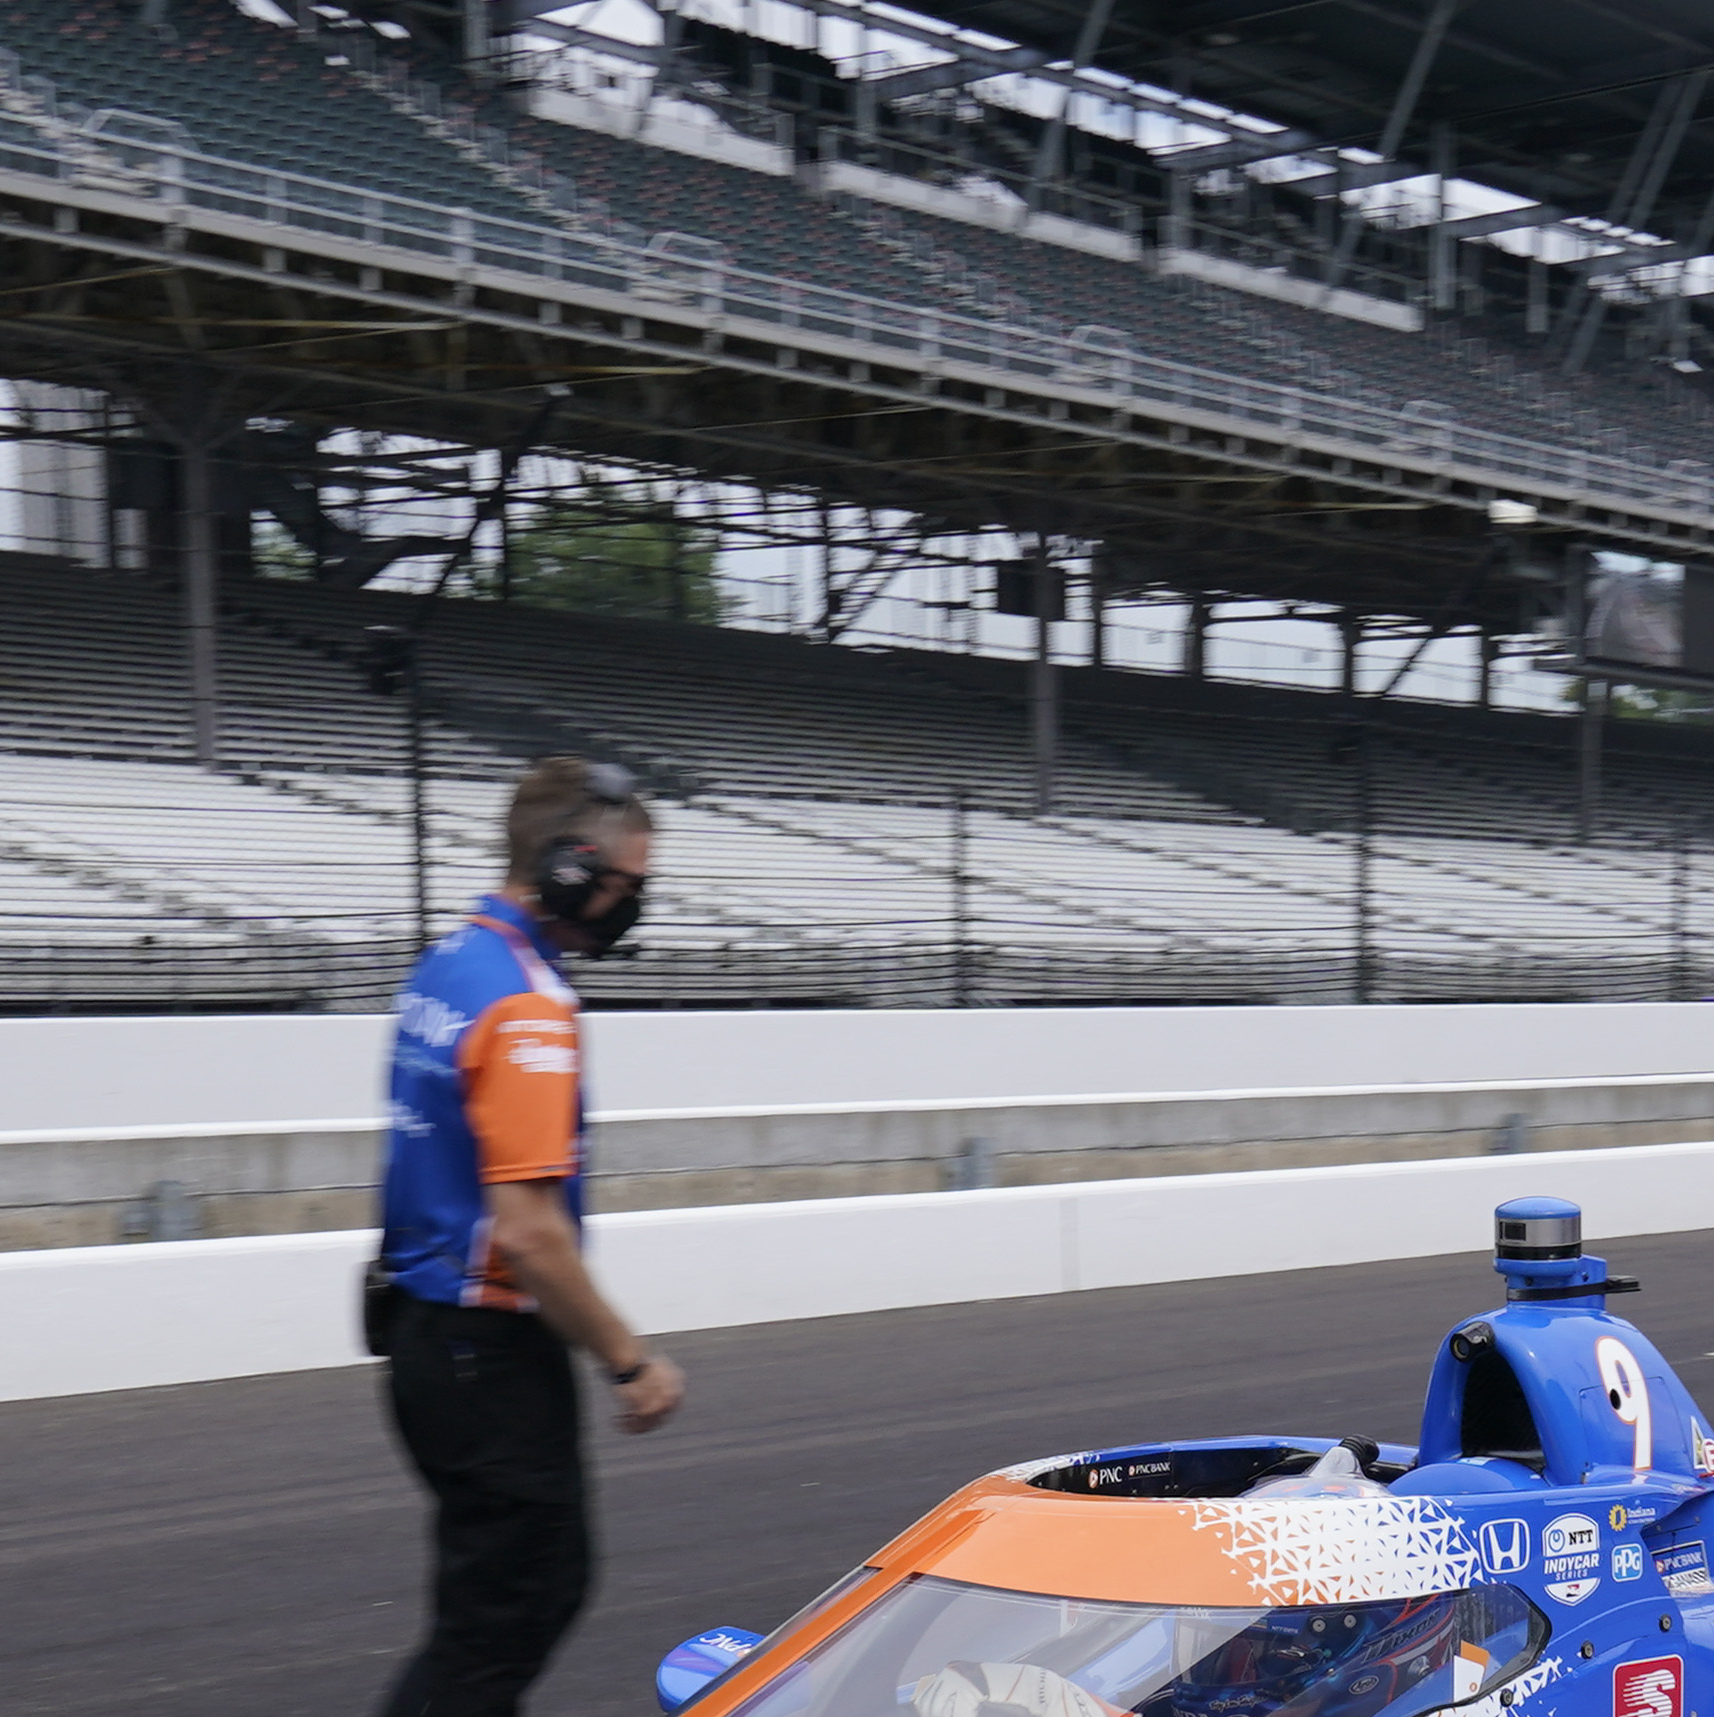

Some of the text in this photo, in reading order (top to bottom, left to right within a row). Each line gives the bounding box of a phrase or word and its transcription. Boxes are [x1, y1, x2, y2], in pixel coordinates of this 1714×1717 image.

[1595, 1335, 1652, 1470] 9
[1099, 1465, 1123, 1485] PNC
[1135, 1461, 1171, 1475] PNCBANK
[1568, 1529, 1594, 1545] NTT
[1544, 1553, 1600, 1575] INDYCAR
[1555, 1569, 1589, 1582] SERIES
